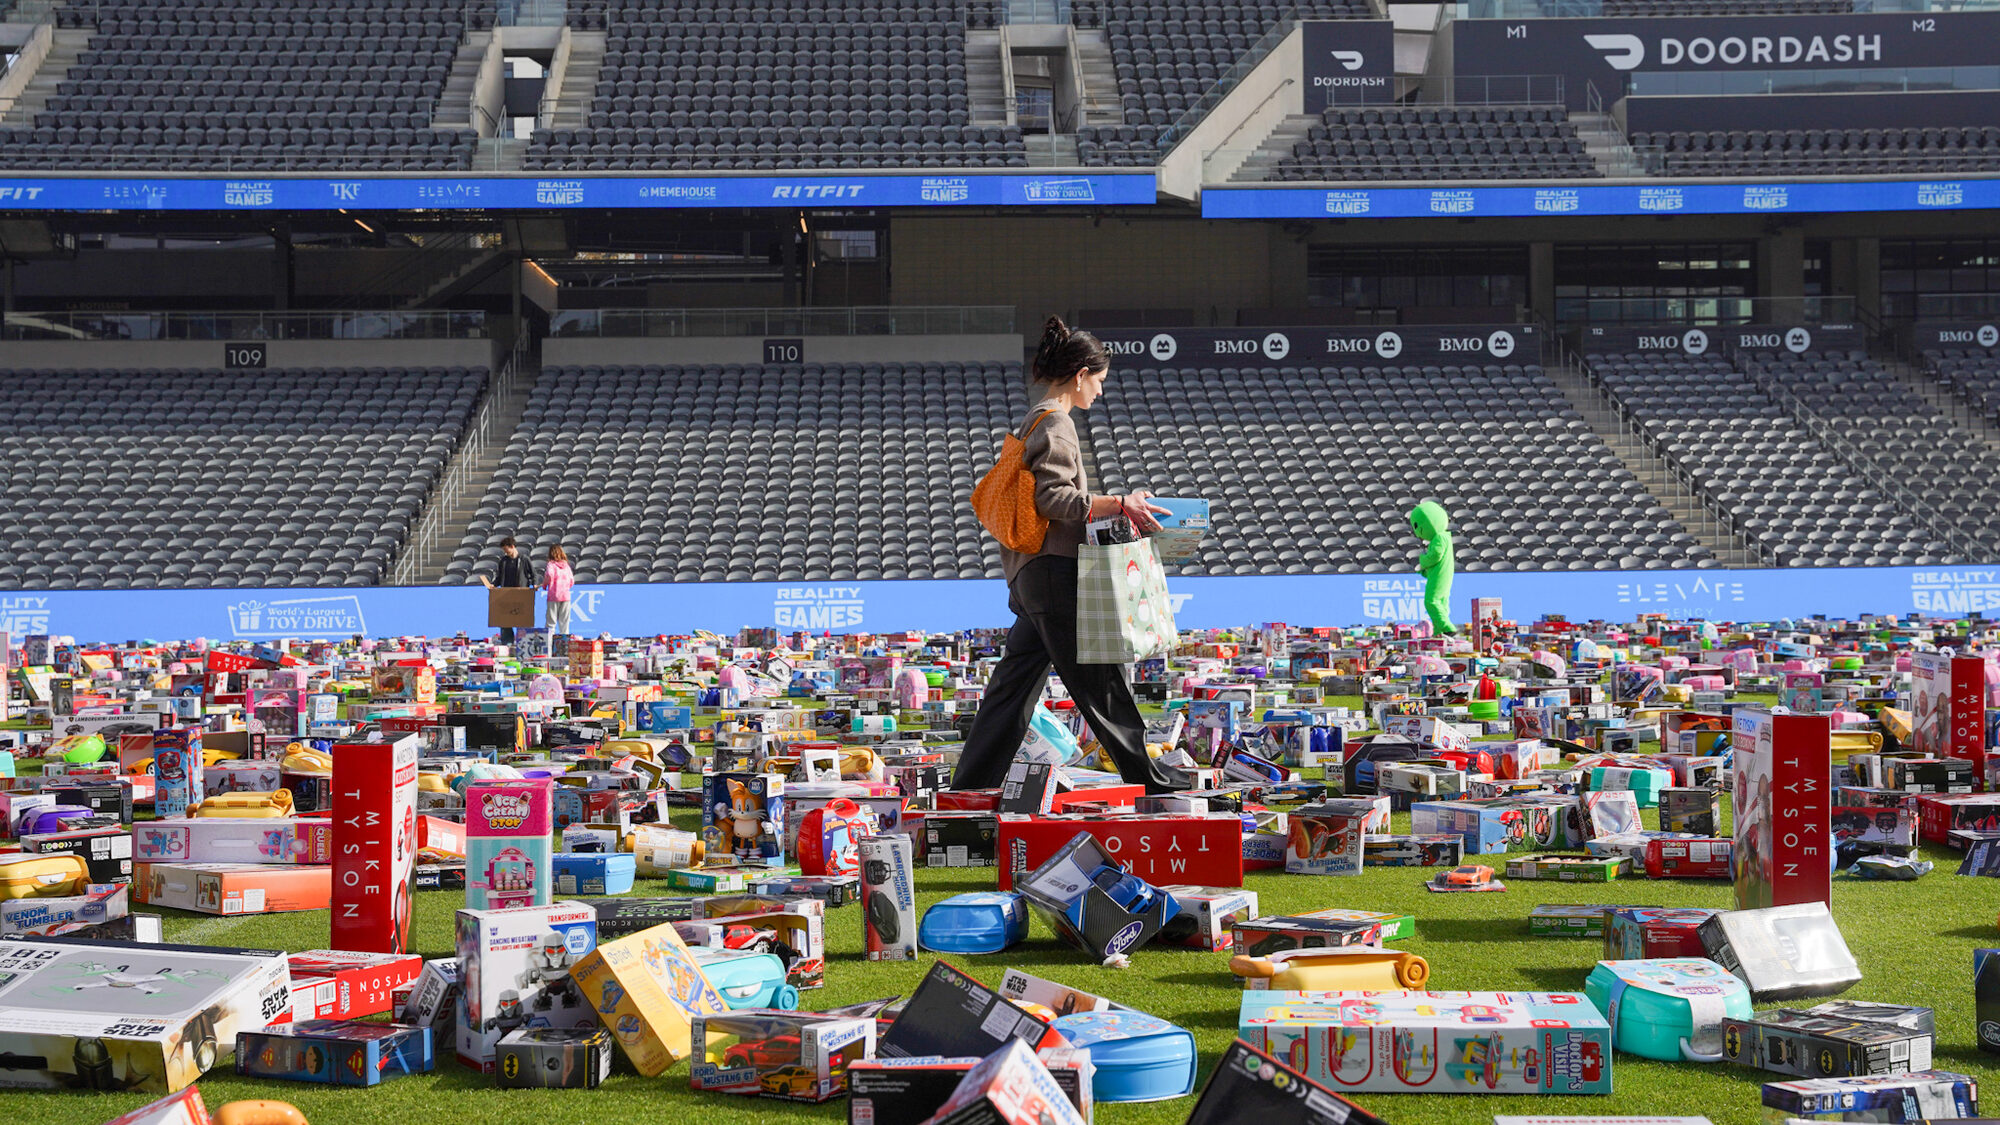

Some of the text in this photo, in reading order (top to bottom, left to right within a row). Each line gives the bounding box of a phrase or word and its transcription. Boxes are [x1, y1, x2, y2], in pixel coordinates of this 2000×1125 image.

[1507, 25, 1527, 38] M1
[1912, 19, 1935, 31] M2
[1661, 34, 1882, 64] DOORDASH
[1313, 77, 1386, 86] DOORDASH
[329, 183, 362, 200] TKF
[538, 181, 582, 189] REALITY
[772, 185, 864, 198] RITFIT
[536, 192, 584, 205] GAMES
[651, 187, 716, 197] MEMEHOUSE
[921, 189, 968, 202] GAMES
[1043, 190, 1090, 198] TOY DRIVE
[225, 193, 273, 206] GAMES
[1534, 200, 1578, 212] GAMES
[1639, 198, 1683, 211] GAMES
[1744, 197, 1788, 209] GAMES
[1917, 194, 1963, 206] GAMES
[1326, 202, 1370, 214] GAMES
[1430, 200, 1474, 213] GAMES
[1638, 336, 1679, 349] BMO
[1740, 334, 1780, 347] BMO
[1939, 330, 1974, 342] BMO
[1102, 341, 1145, 355] BMO
[1214, 340, 1258, 354] BMO
[1327, 339, 1371, 353] BMO
[1439, 337, 1483, 352] BMO
[229, 349, 262, 366] 109
[768, 346, 799, 362] 110
[1912, 571, 1996, 583] REALITY
[1364, 579, 1428, 590] REALI
[776, 587, 861, 599] REALITY
[1912, 590, 2000, 613] GAMES
[267, 606, 346, 618] World's Largest
[1363, 598, 1429, 620] GAM
[267, 615, 356, 629] TOY DRIVE
[774, 605, 863, 629] GAMES
[1957, 682, 1967, 754] TYSON
[1969, 695, 1978, 742] MIKE
[495, 795, 517, 807] ICE
[484, 805, 528, 817] CREAM
[1783, 757, 1799, 876] TYSON
[1803, 778, 1817, 856] MIKE
[491, 818, 521, 827] STOP
[316, 827, 325, 861] QUEEN
[1105, 835, 1210, 853] TYSO
[343, 789, 360, 917] TYSON
[365, 811, 380, 894] MIKE
[1122, 858, 1186, 874] MIK
[891, 843, 912, 906] LAMBORGHINI
[5, 906, 48, 922] VENOM
[16, 911, 73, 929] TUMBLER
[547, 912, 589, 923] TRANSFORMERS
[490, 935, 537, 945] DANCING MEGATRON
[1112, 926, 1137, 950] Ford
[570, 941, 585, 949] MODE
[360, 971, 411, 993] TYSON
[1008, 975, 1028, 987] STAR
[1006, 982, 1027, 994] WARS
[261, 985, 289, 1010] WARS
[263, 995, 289, 1020] STAR
[820, 1030, 836, 1042] FORD
[828, 1024, 865, 1047] MUSTANG GT
[1554, 1043, 1568, 1076] Visit
[1567, 1030, 1584, 1092] Doctor's
[694, 1067, 715, 1077] FORD
[703, 1071, 754, 1085] MUSTANG GT
